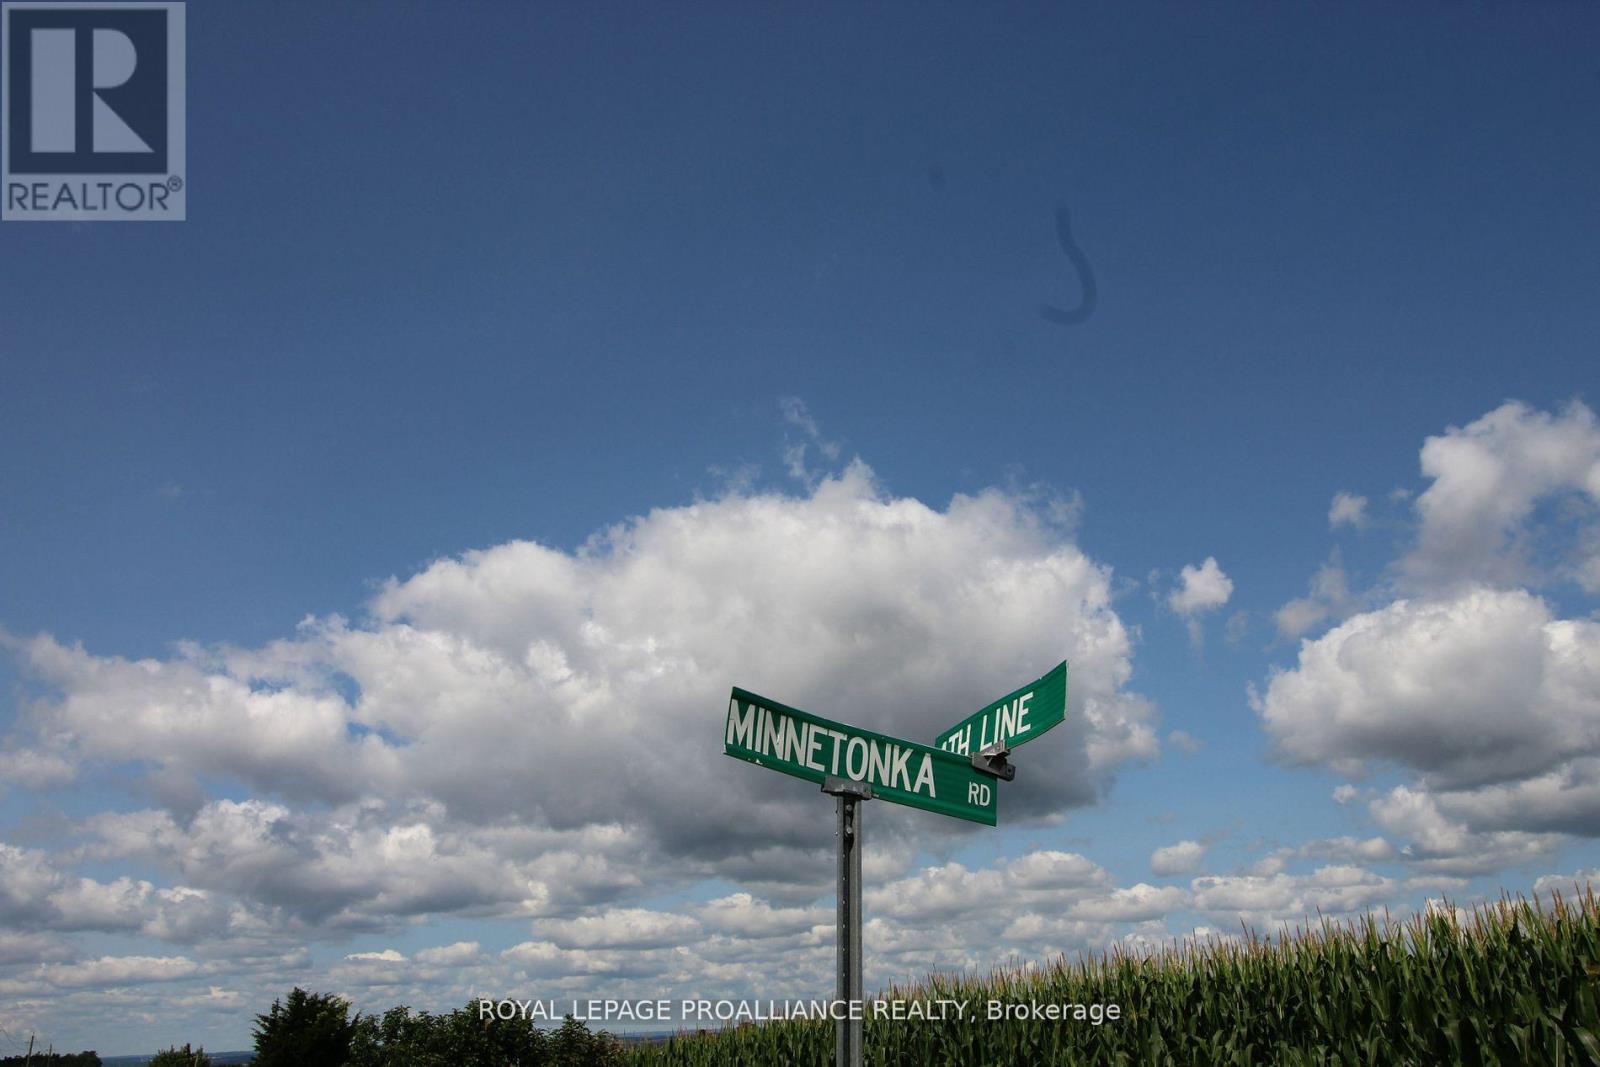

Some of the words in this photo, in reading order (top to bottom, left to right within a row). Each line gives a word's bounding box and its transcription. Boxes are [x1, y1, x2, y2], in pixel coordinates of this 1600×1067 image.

[726, 698, 936, 798] MINNETONKA
[968, 781, 991, 806] RD
[980, 691, 1034, 752] LINE
